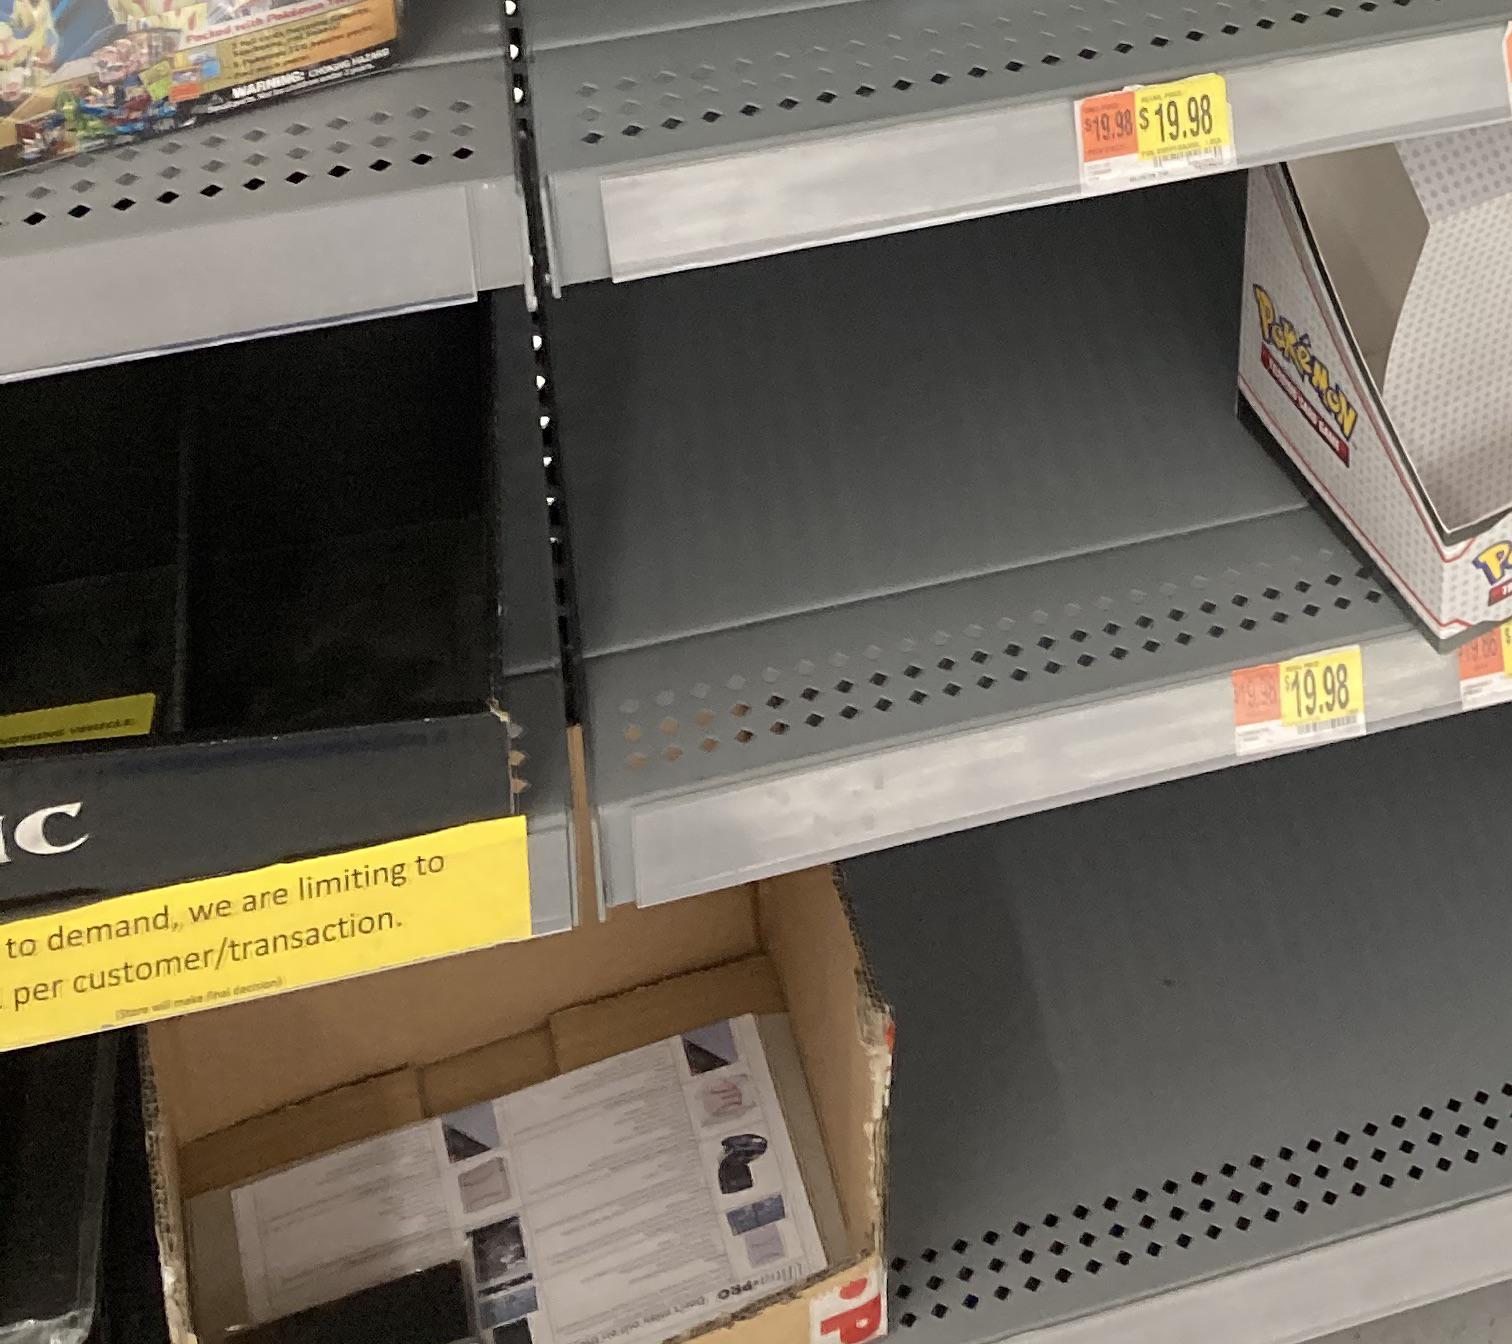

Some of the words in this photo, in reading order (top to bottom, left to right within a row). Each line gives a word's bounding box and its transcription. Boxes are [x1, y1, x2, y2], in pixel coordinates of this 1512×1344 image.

[1139, 94, 1213, 142] $19.98
[1285, 663, 1350, 718] $19.98
[5, 938, 36, 960] to
[48, 905, 178, 953] demand,
[188, 899, 234, 925] we
[242, 885, 289, 914] are
[298, 859, 406, 902] limiting
[415, 852, 445, 876] to
[14, 981, 63, 1013] per
[72, 915, 403, 993] customer/transaction.
